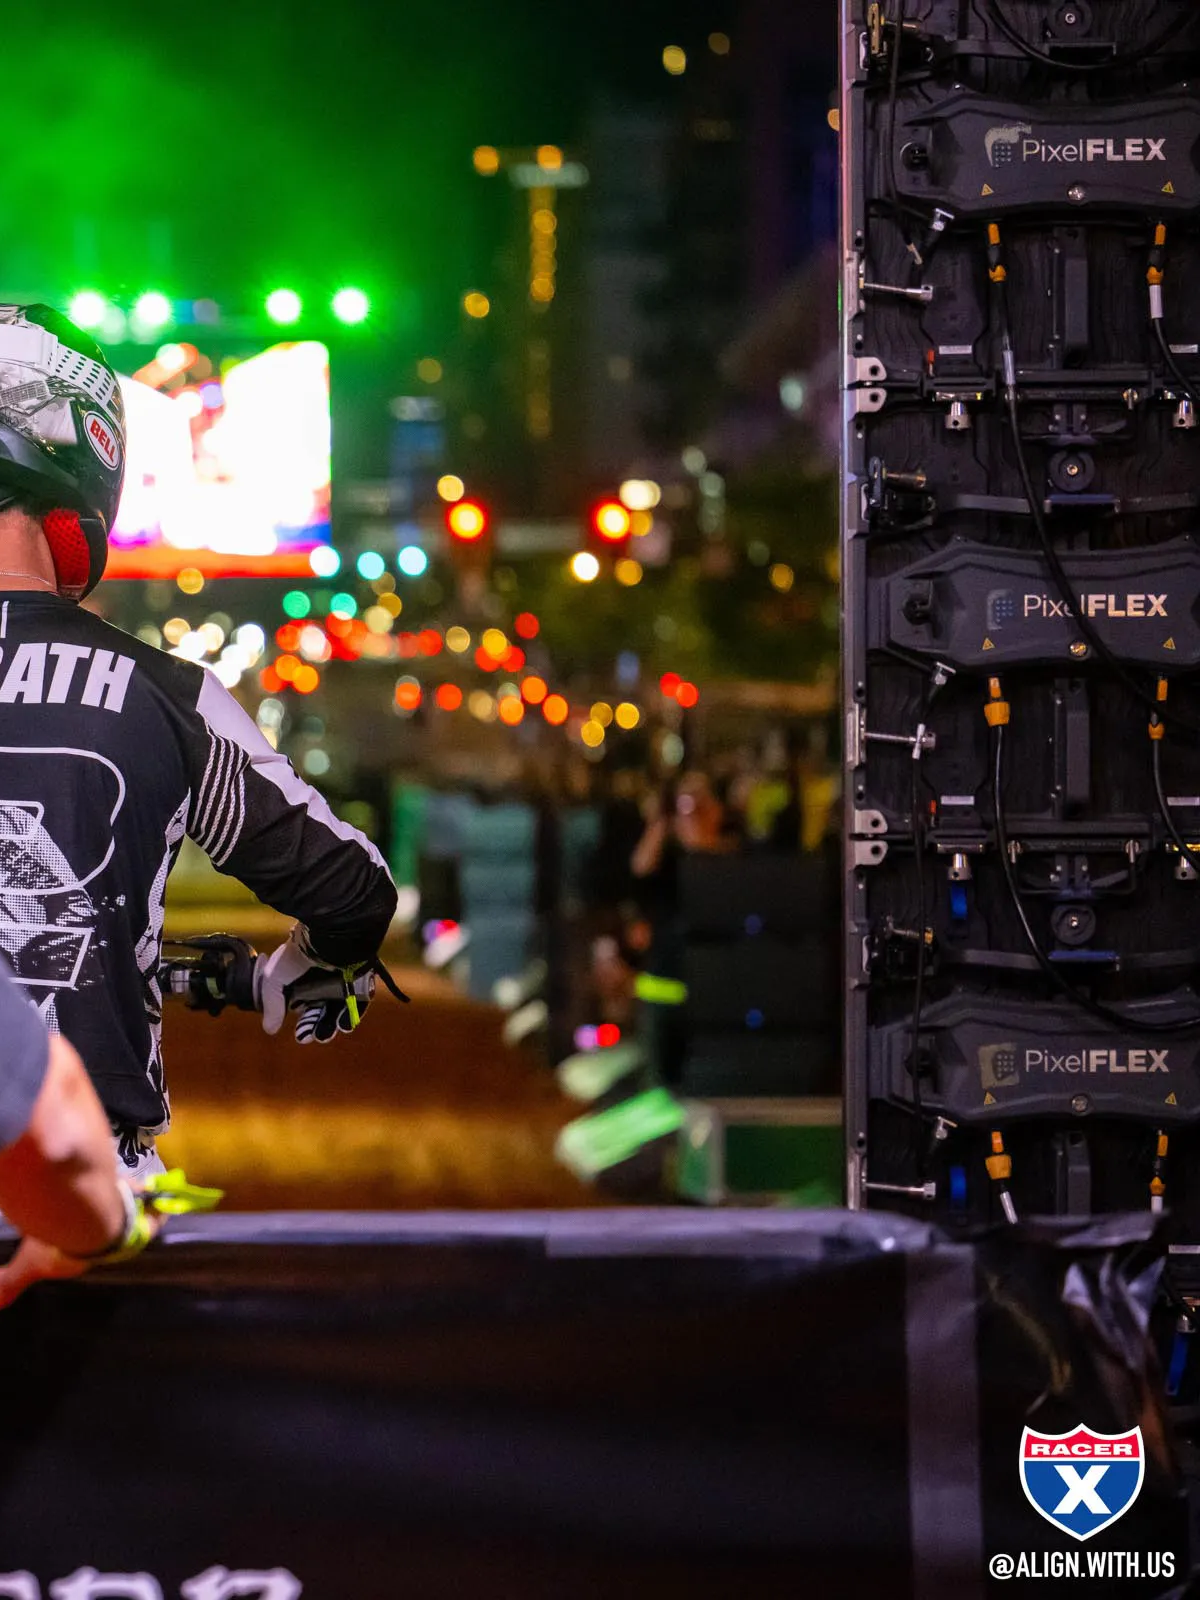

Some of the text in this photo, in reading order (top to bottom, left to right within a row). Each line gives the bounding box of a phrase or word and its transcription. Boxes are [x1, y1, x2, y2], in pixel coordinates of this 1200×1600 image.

[1022, 138, 1166, 162] PixelFLEX
[90, 418, 116, 463] BELL
[1025, 1049, 1169, 1073] PixelFLEX
